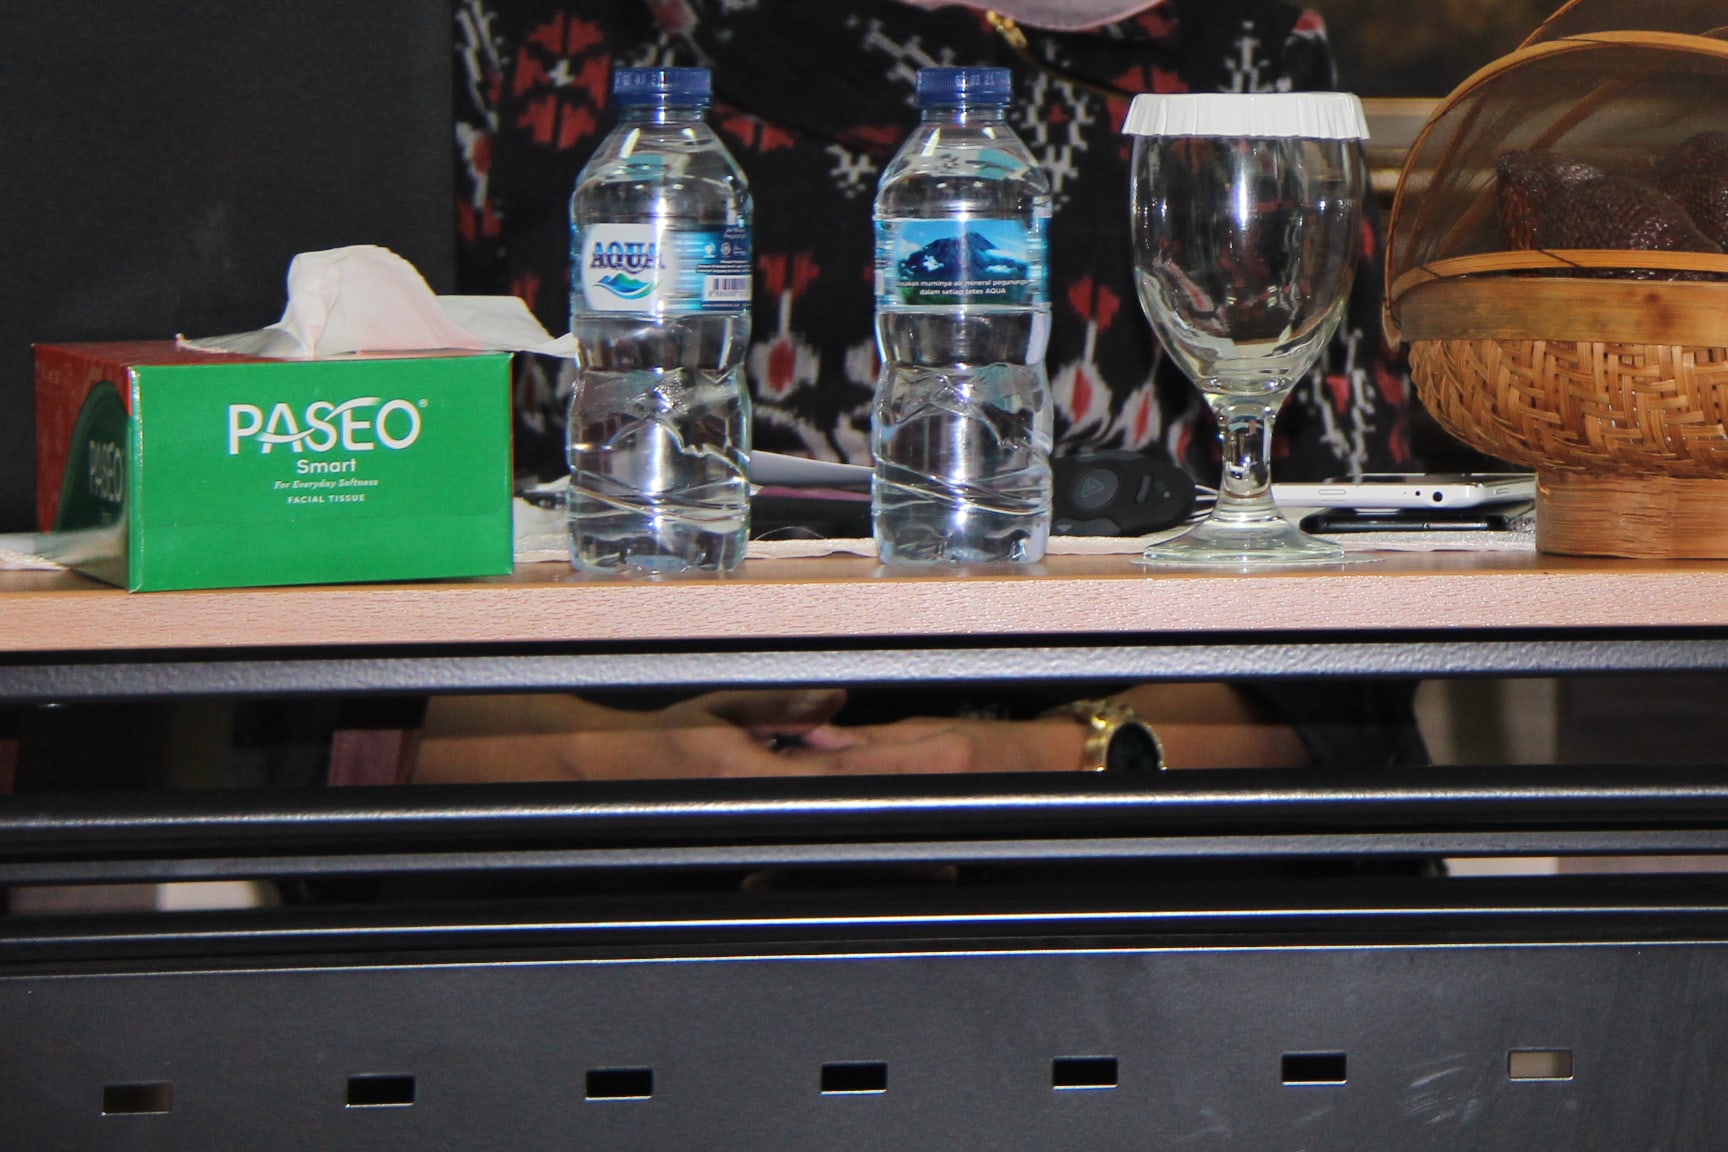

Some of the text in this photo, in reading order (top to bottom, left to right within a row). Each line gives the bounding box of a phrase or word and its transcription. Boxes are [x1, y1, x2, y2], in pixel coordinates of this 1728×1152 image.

[590, 241, 666, 274] AQUA
[965, 279, 992, 287] mineral
[985, 287, 1007, 295] AQUA
[296, 458, 357, 474] Smart
[273, 477, 379, 490] For Everyday Softness
[287, 494, 366, 504] FACIAL TISSUE
